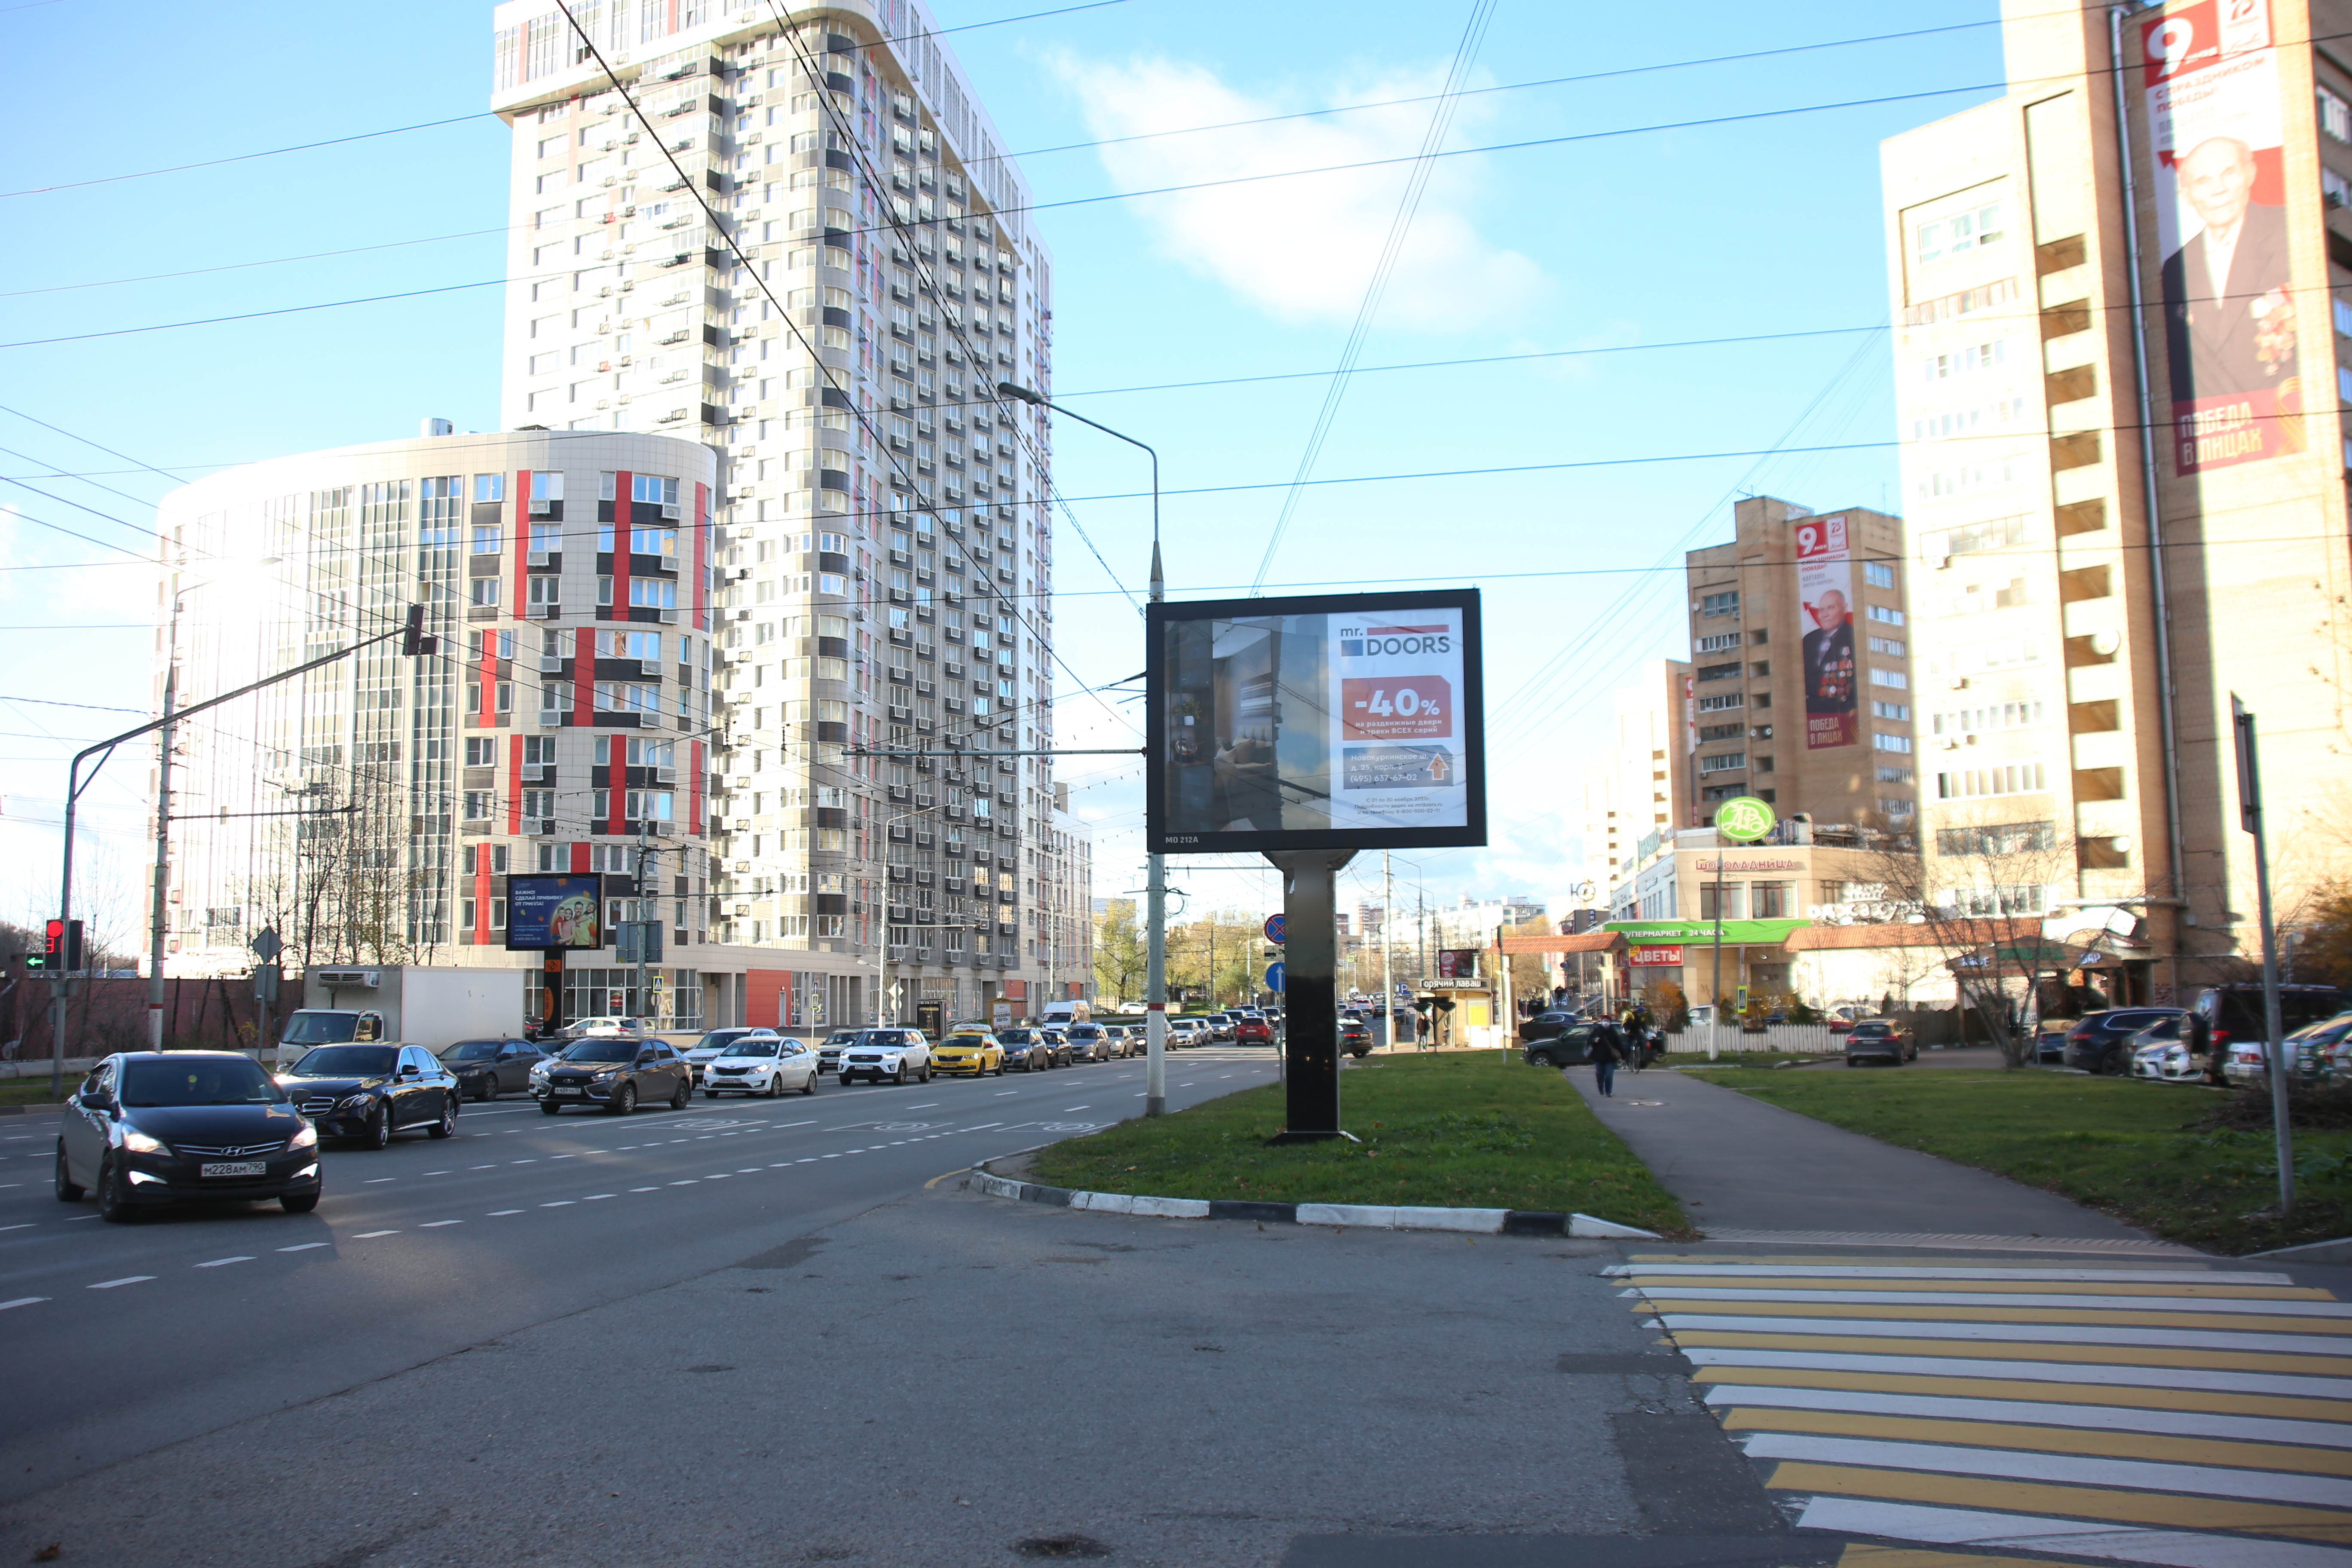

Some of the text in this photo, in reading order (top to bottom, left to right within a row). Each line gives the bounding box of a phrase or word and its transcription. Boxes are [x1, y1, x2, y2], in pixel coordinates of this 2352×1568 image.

[2148, 18, 2194, 78] 9
[2167, 56, 2265, 93] ПРАЗДНИКОМ
[2180, 401, 2253, 438] ПОБЕДА
[2183, 427, 2263, 467] В ЛИЦАХ
[1799, 527, 1817, 554] 9
[1807, 553, 1846, 564] ПРАЗДНИКОМ
[1802, 563, 1828, 572] ПОБЕДЫ!
[1341, 628, 1451, 656] mr. DOORS
[1356, 689, 1440, 717] -40%
[1810, 717, 1839, 731] ПОБЕДА
[1811, 731, 1842, 744] В ЛИЦАХ
[1351, 775, 1372, 783] (495)
[46, 937, 63, 953] 31
[1635, 950, 1681, 964] ЦВЕТЫ
[1420, 979, 1454, 989] Горячий
